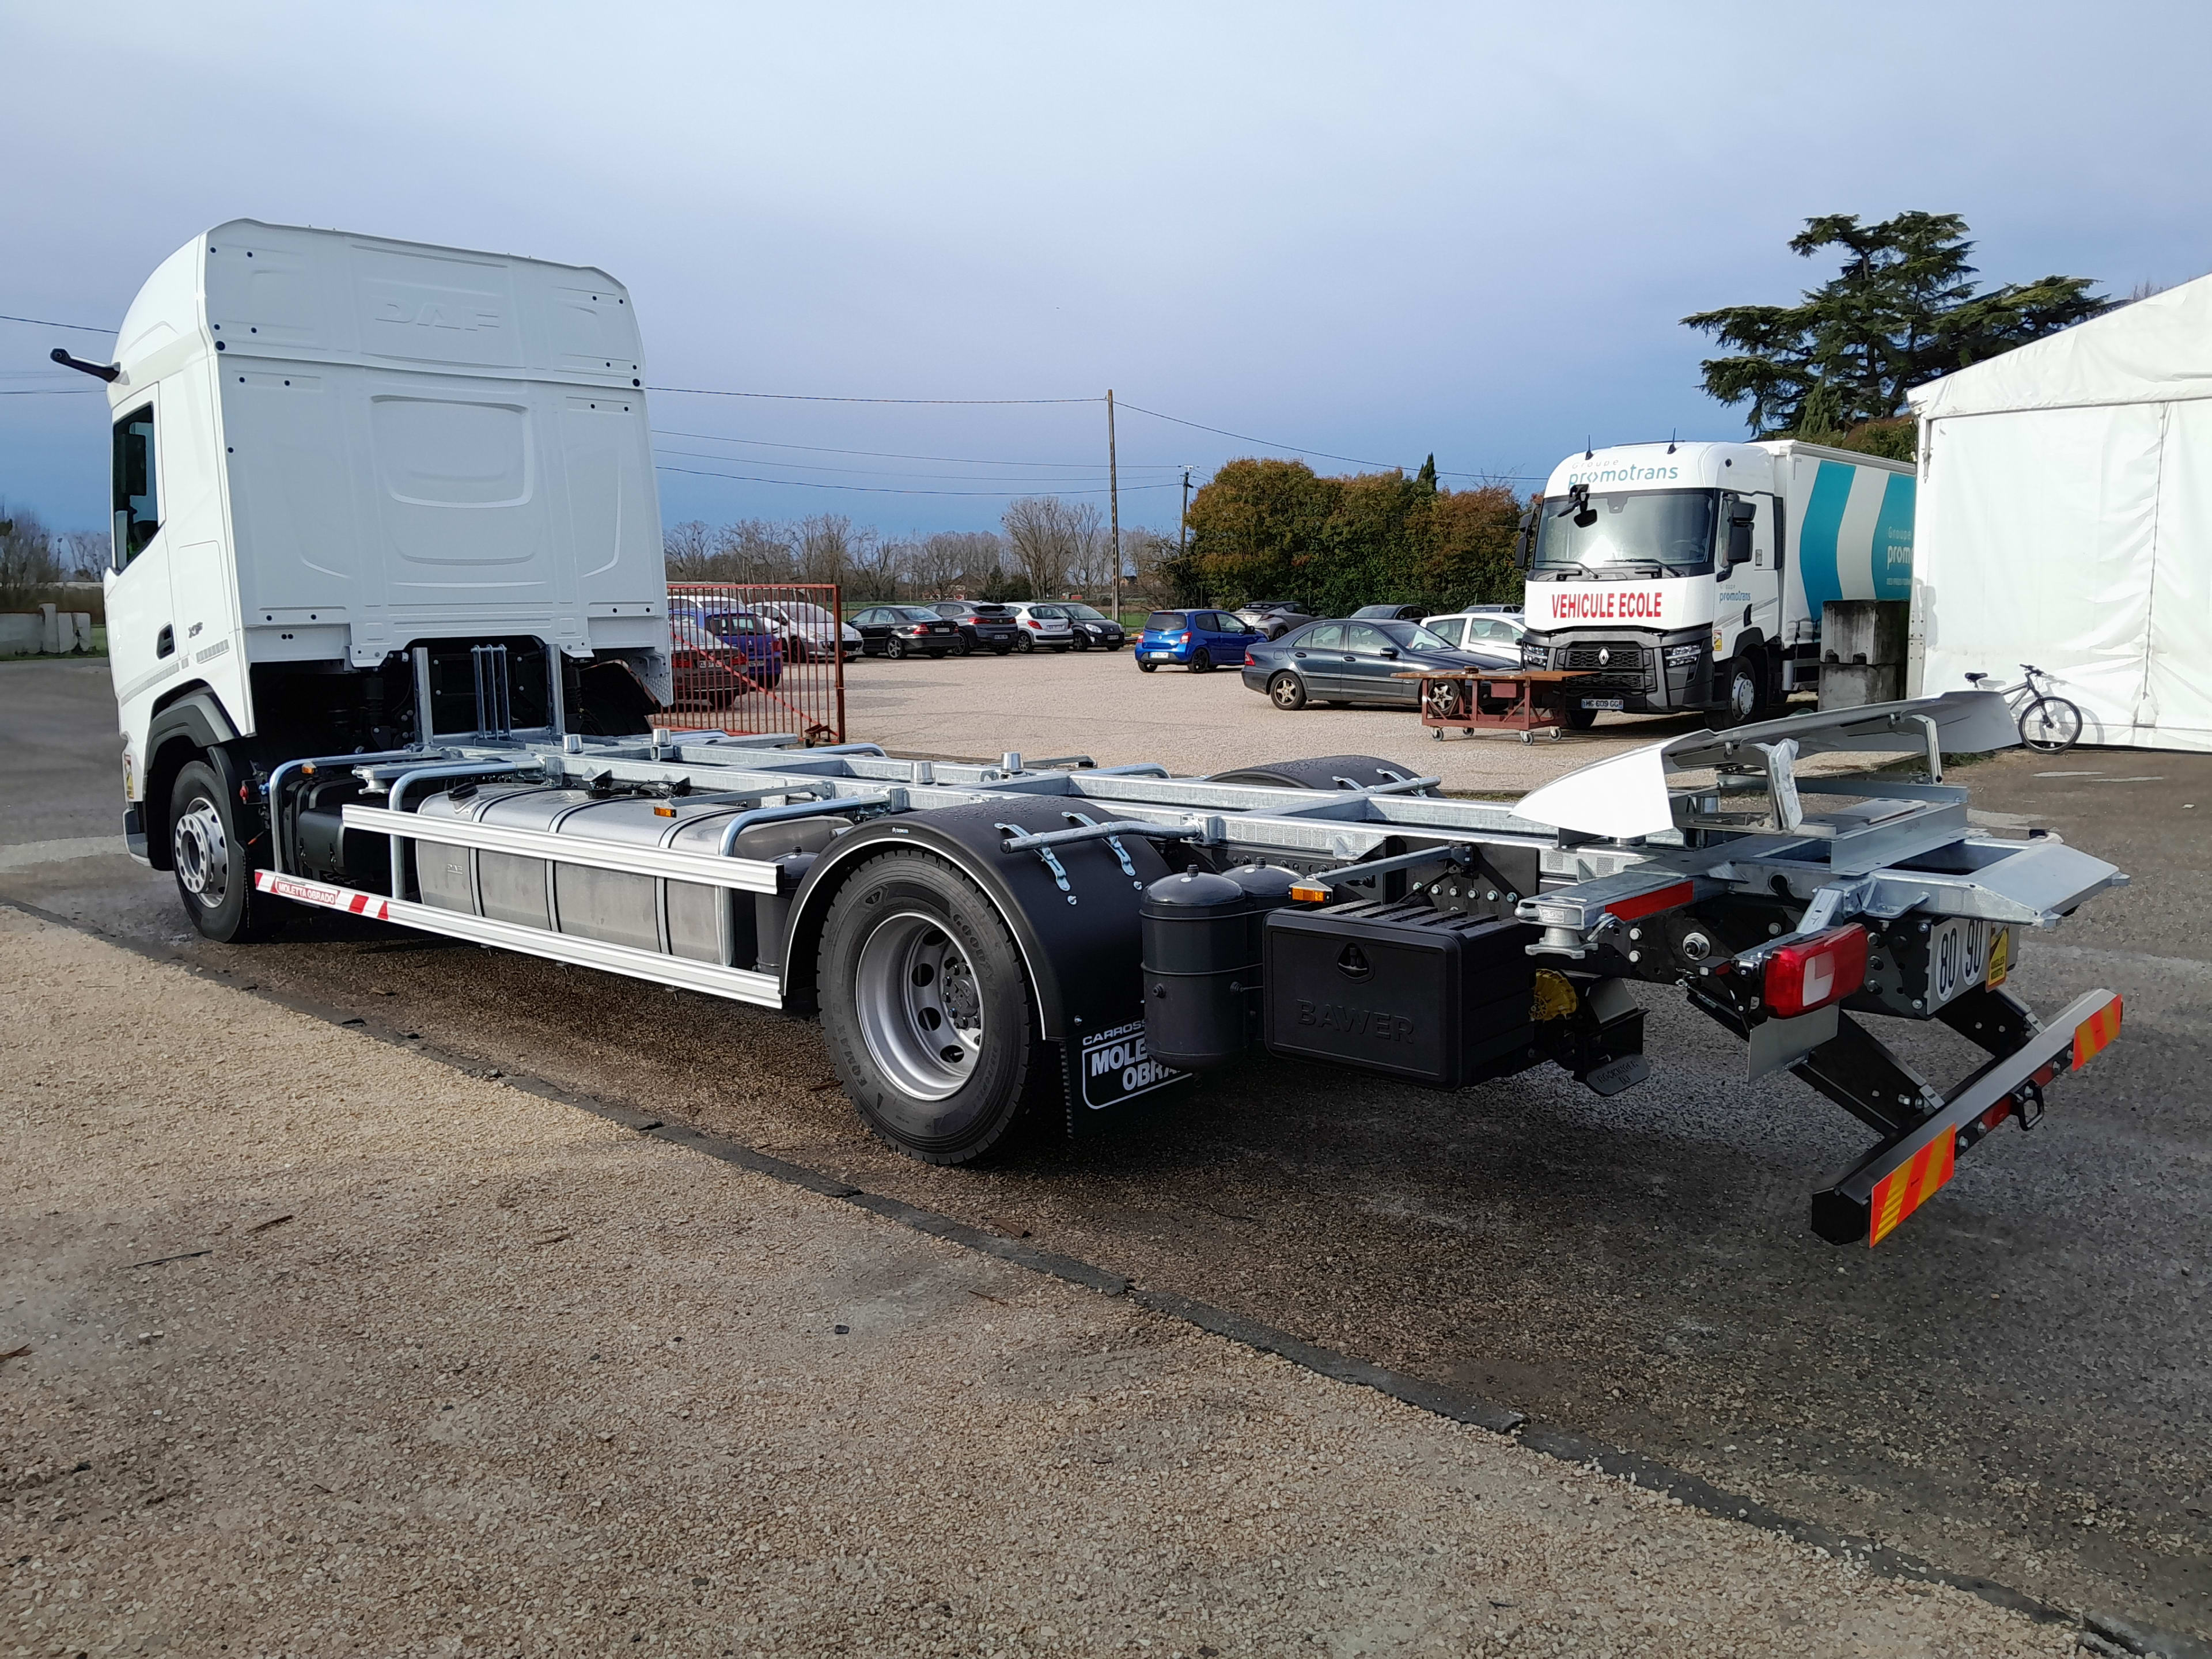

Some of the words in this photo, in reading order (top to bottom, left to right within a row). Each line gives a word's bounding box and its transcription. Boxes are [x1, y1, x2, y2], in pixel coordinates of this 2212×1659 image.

[1568, 464, 1679, 490] promotrans
[1552, 593, 1615, 619] VEHICULE
[1619, 592, 1662, 618] ECOLE
[278, 882, 307, 898] MOLETTA
[307, 889, 335, 904] OBRADO
[1940, 927, 1957, 994] 80
[1965, 919, 1983, 978] 90
[1296, 999, 1415, 1044] BAWER
